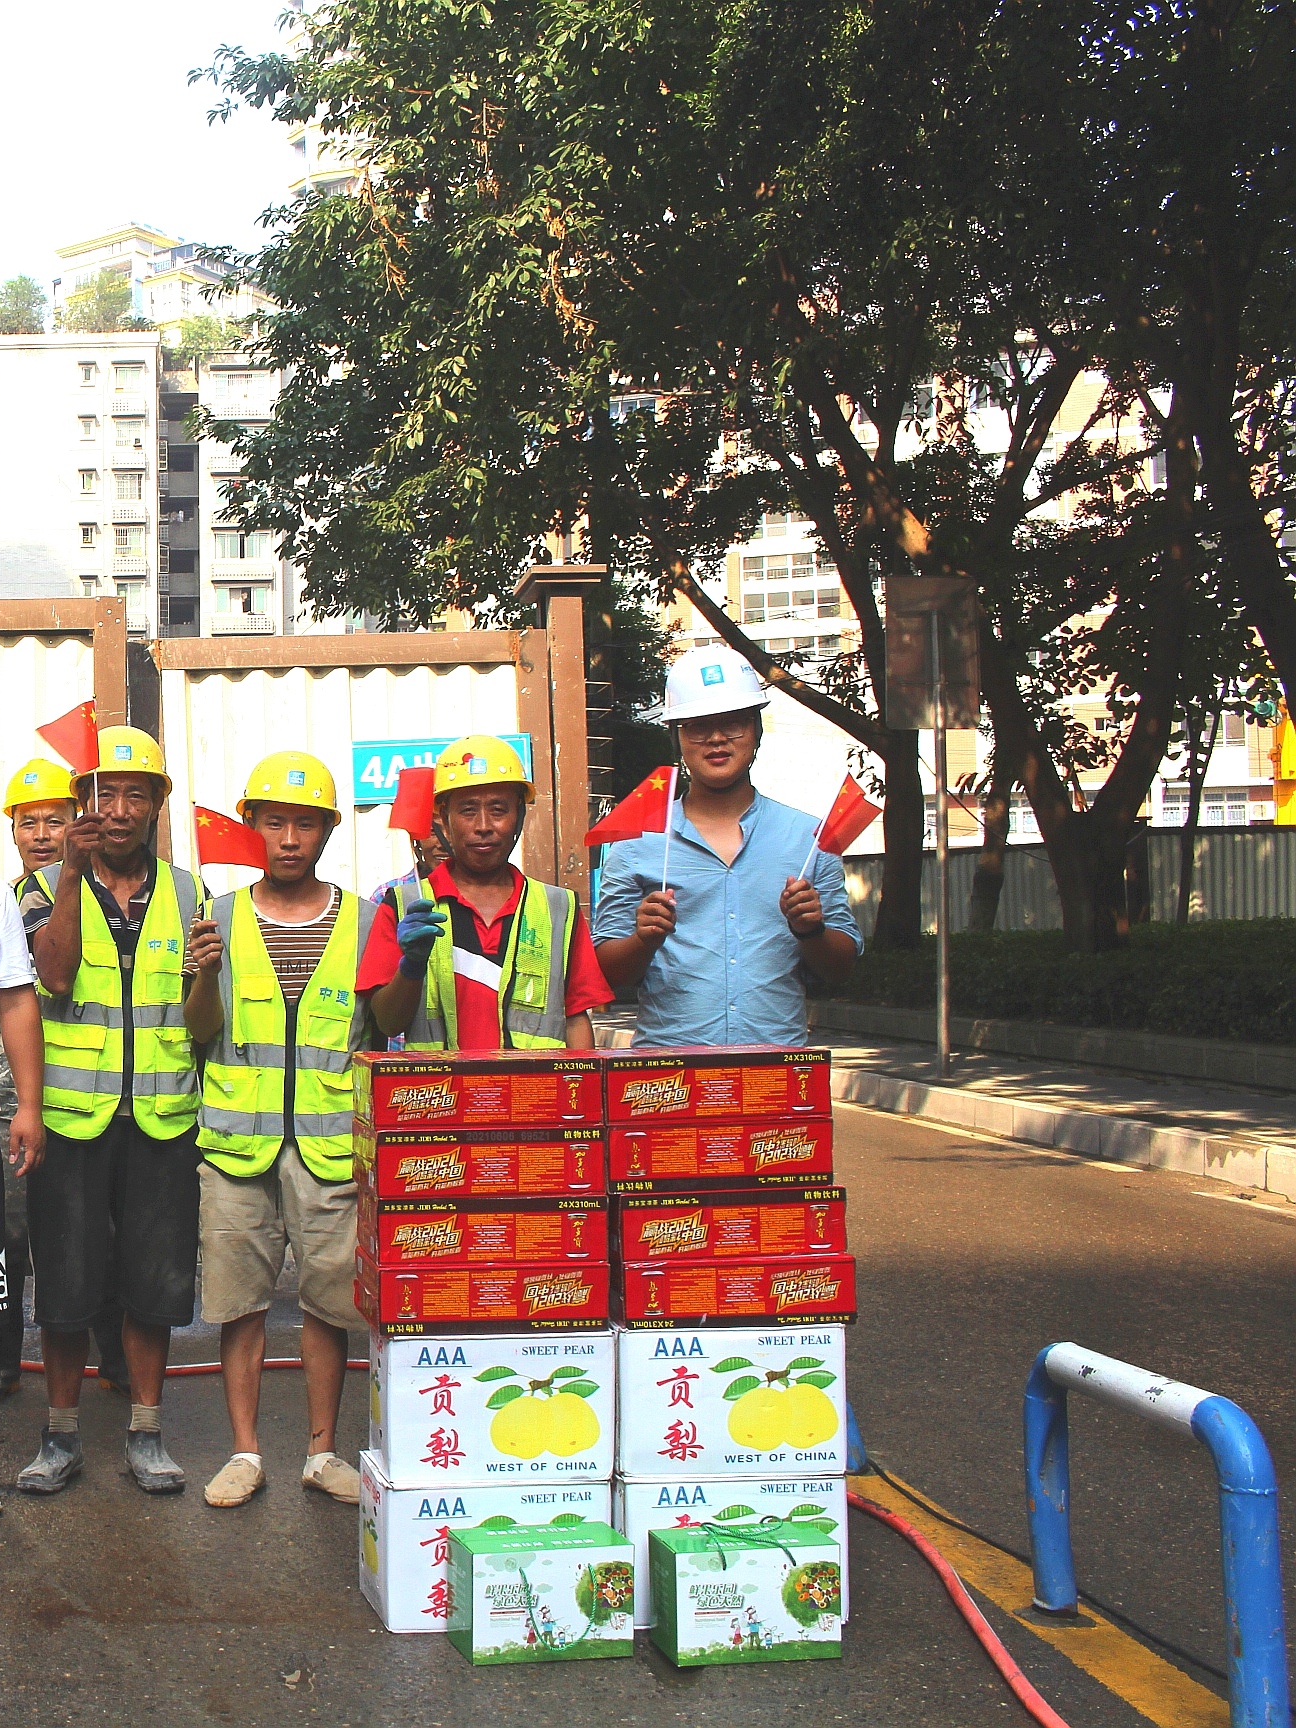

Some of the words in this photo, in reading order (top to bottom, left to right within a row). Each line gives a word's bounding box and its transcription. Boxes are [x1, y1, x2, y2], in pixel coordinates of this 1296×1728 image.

[563, 1130, 601, 1139] 植物饮料
[804, 1190, 840, 1200] 植物饮料
[654, 1336, 704, 1357] AAA
[757, 1335, 795, 1346] SWEET
[800, 1334, 832, 1345] PEAR
[417, 1346, 467, 1366] AAA
[521, 1345, 559, 1356] SWEET
[563, 1344, 595, 1355] PEAR
[656, 1365, 705, 1462] 贡梨
[418, 1374, 467, 1469] 贡梨
[724, 1454, 762, 1464] WEST
[768, 1453, 787, 1462] OF
[794, 1451, 837, 1462] CHINA
[486, 1462, 524, 1472] WEST
[530, 1462, 547, 1471] OF
[556, 1461, 598, 1471] CHINA
[760, 1483, 798, 1494] SWEET
[803, 1482, 834, 1493] PEAR
[520, 1493, 557, 1505] SWEET
[562, 1491, 593, 1502] PEAR
[657, 1485, 707, 1506] AAA
[418, 1496, 467, 1517] AAA
[696, 1594, 743, 1608] 绿色天然
